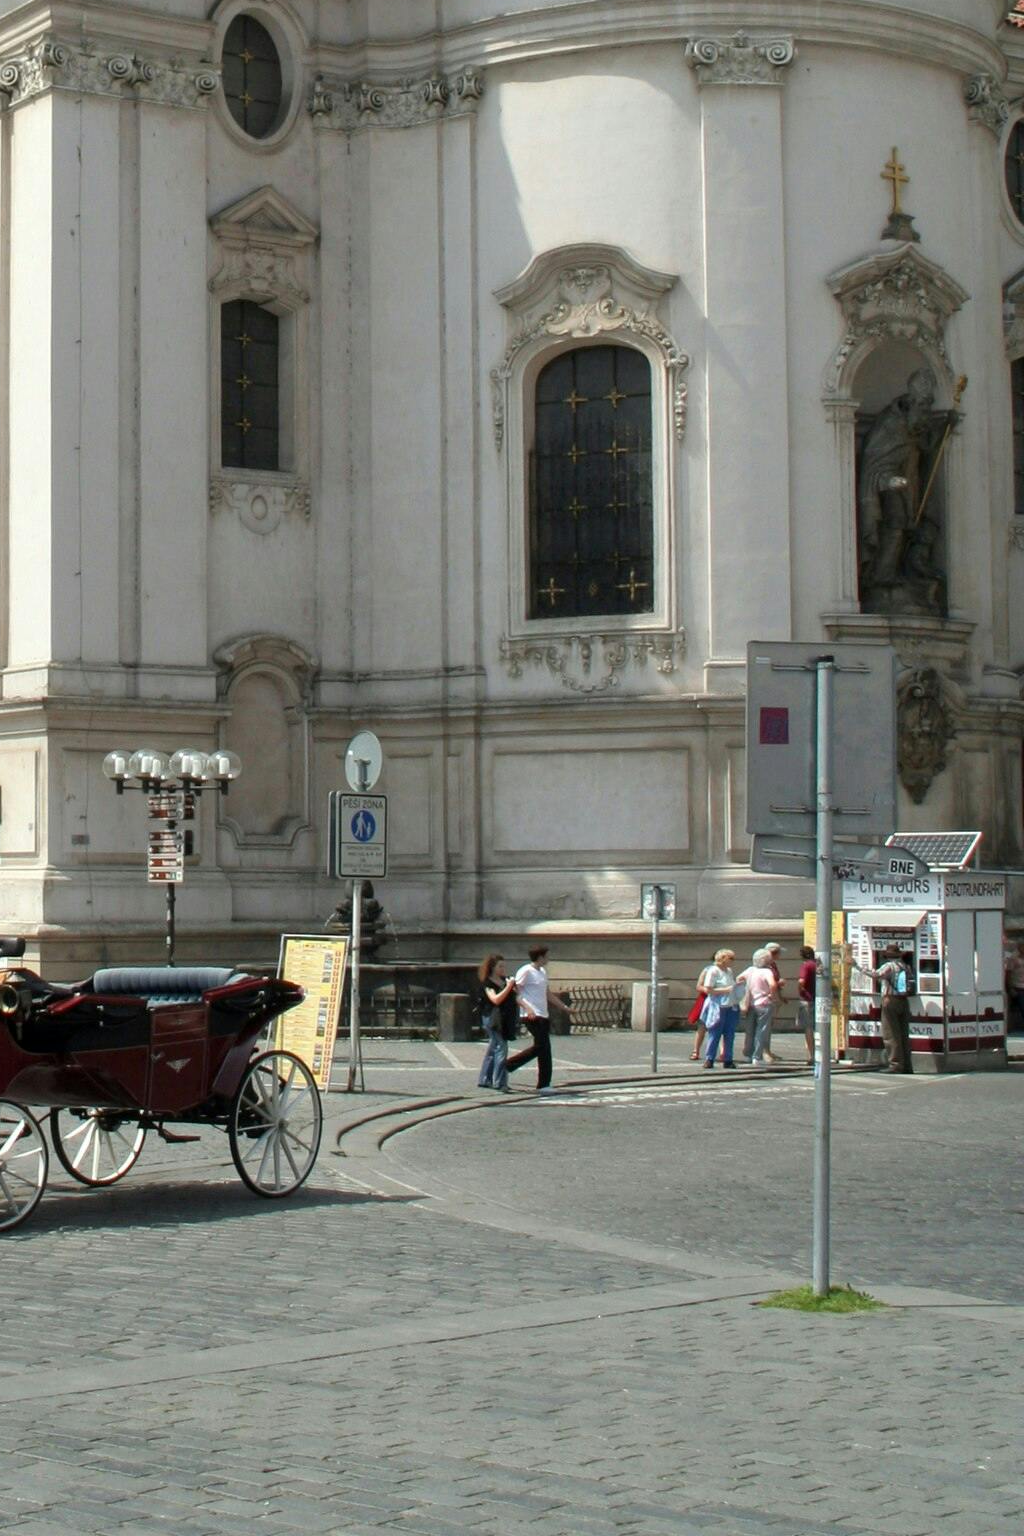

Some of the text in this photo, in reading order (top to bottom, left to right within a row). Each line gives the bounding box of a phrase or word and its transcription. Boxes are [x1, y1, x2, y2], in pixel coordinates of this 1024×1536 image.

[891, 860, 914, 874] BNE
[860, 880, 885, 894] CITY
[889, 879, 930, 894] TOURS
[910, 1026, 933, 1035] OUR
